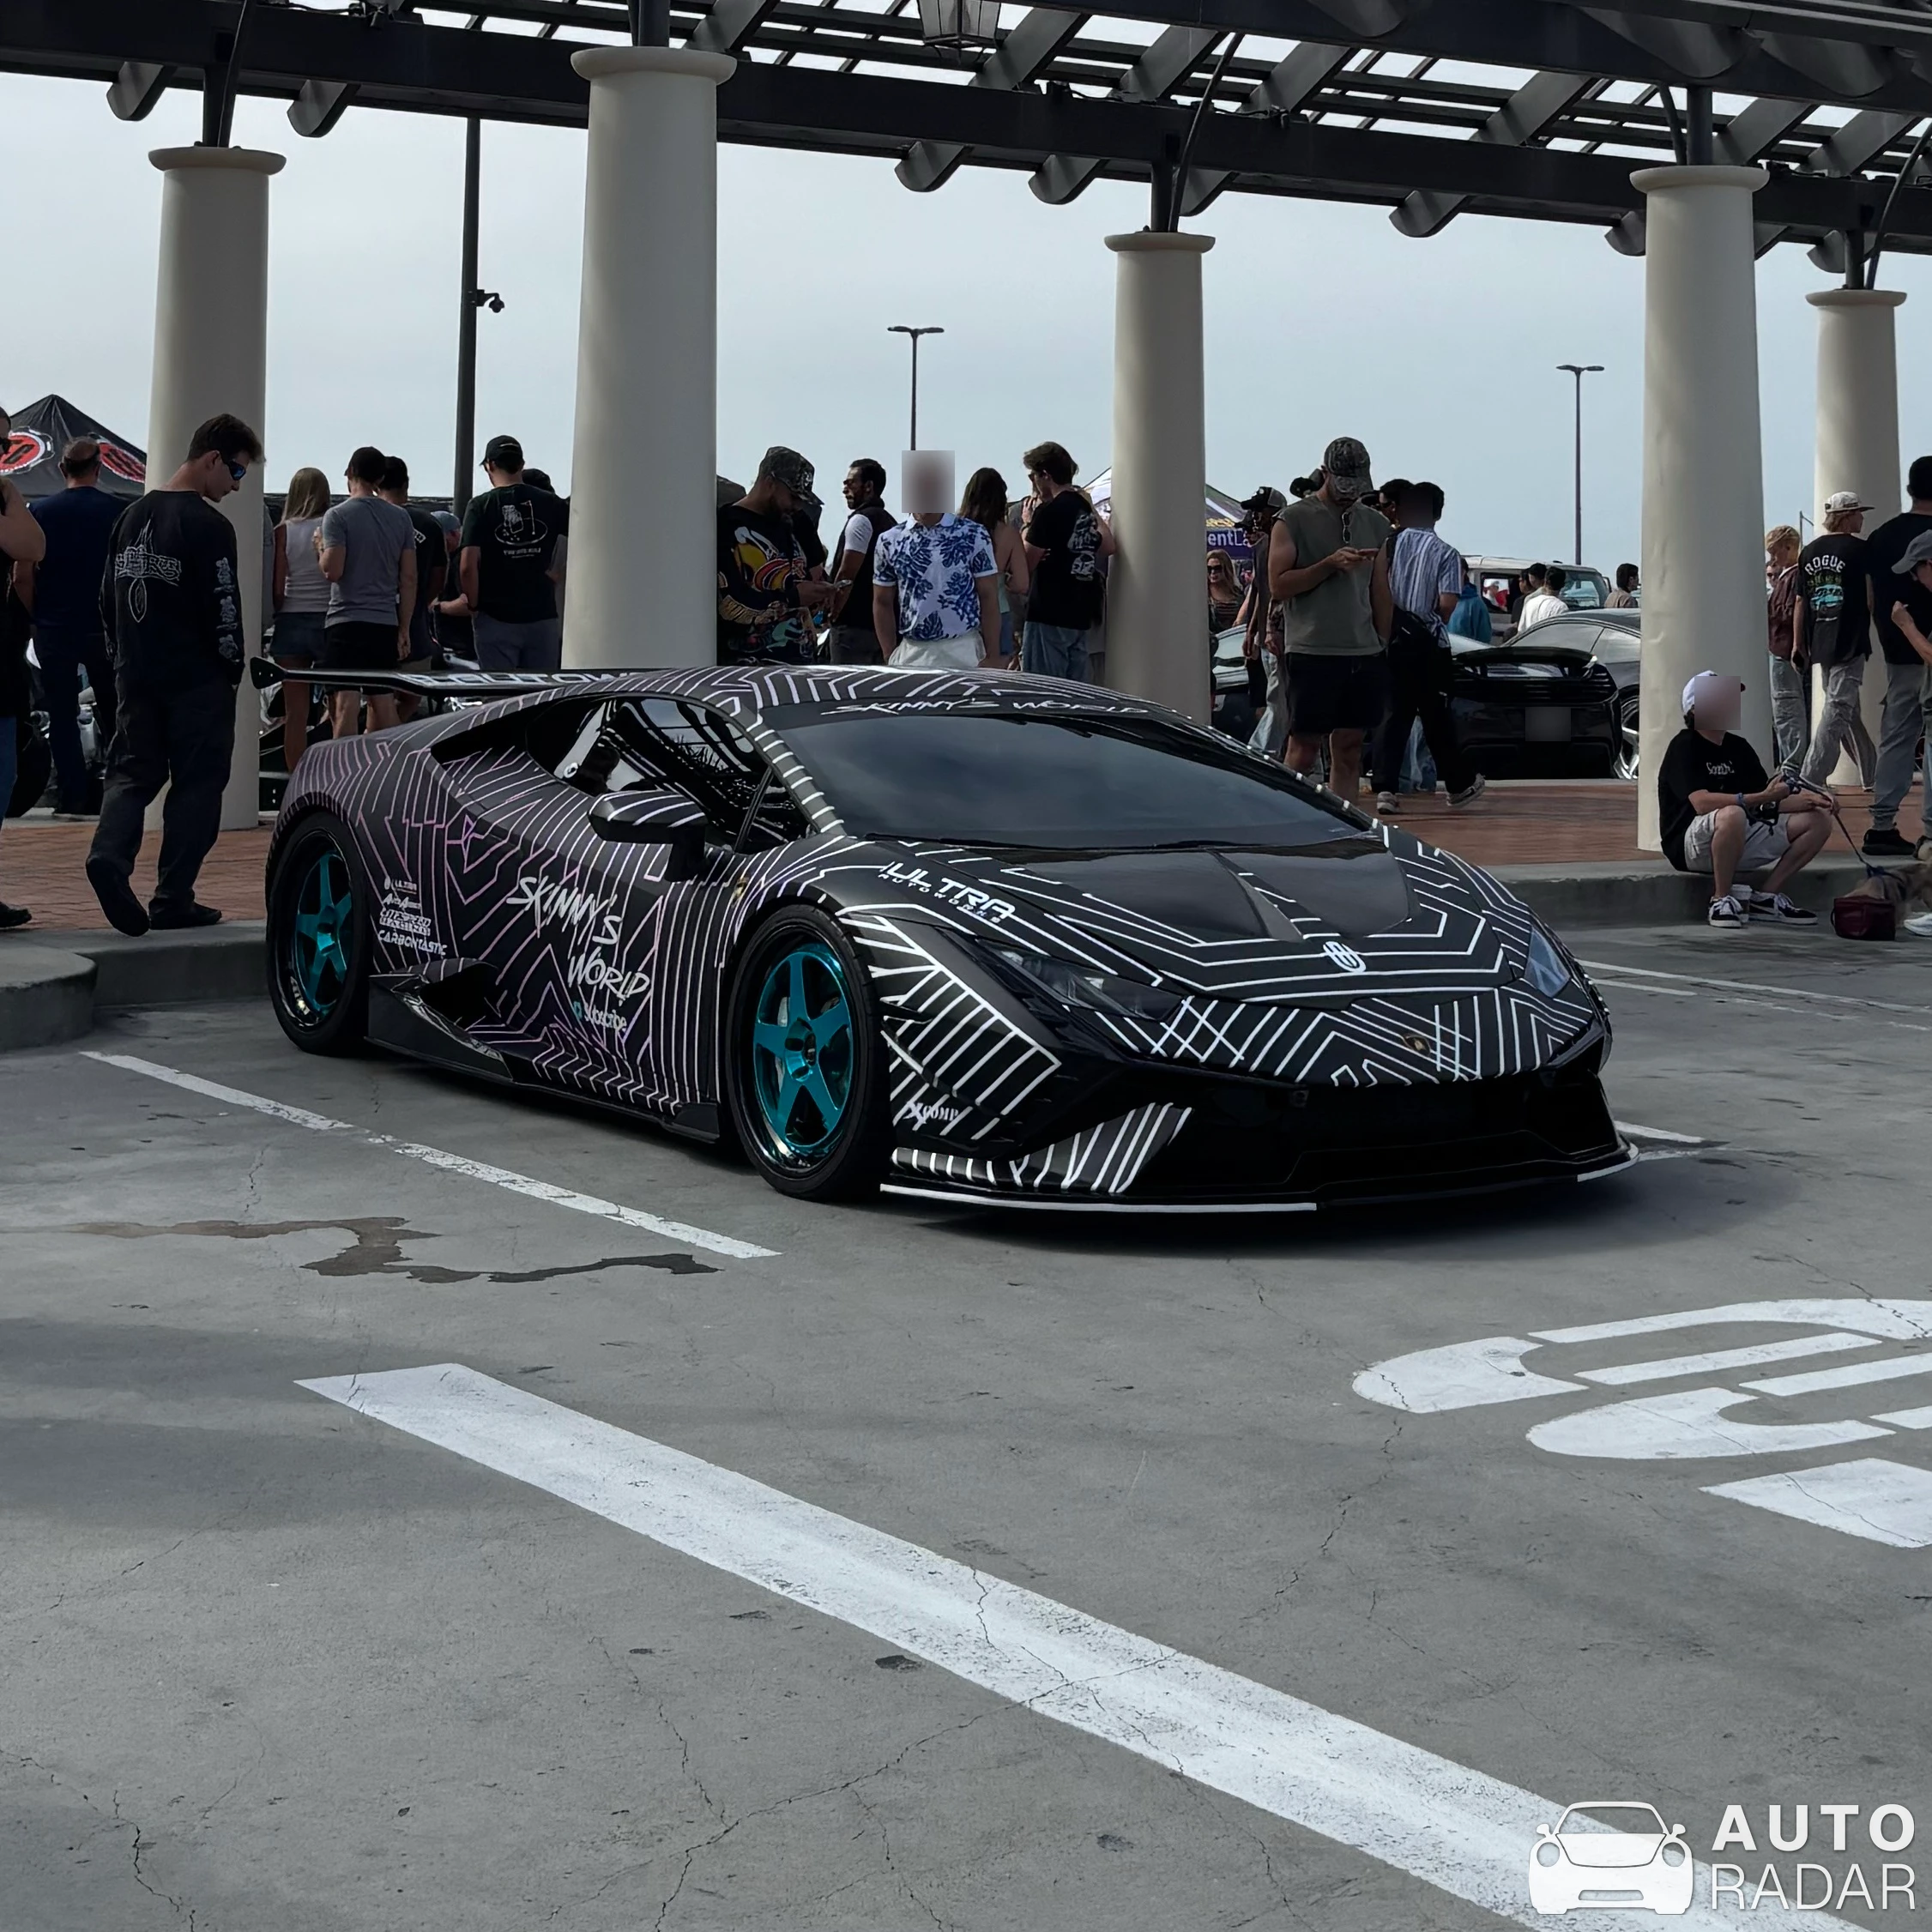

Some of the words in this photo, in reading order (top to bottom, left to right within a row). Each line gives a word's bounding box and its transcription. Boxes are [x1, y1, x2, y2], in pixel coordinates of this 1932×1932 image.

[1804, 554, 1845, 576] ROGUE
[820, 697, 999, 715] SKINNY'S
[1012, 700, 1149, 714] WORLD
[883, 861, 1016, 920] ULTRA
[568, 946, 650, 1006] WORLD
